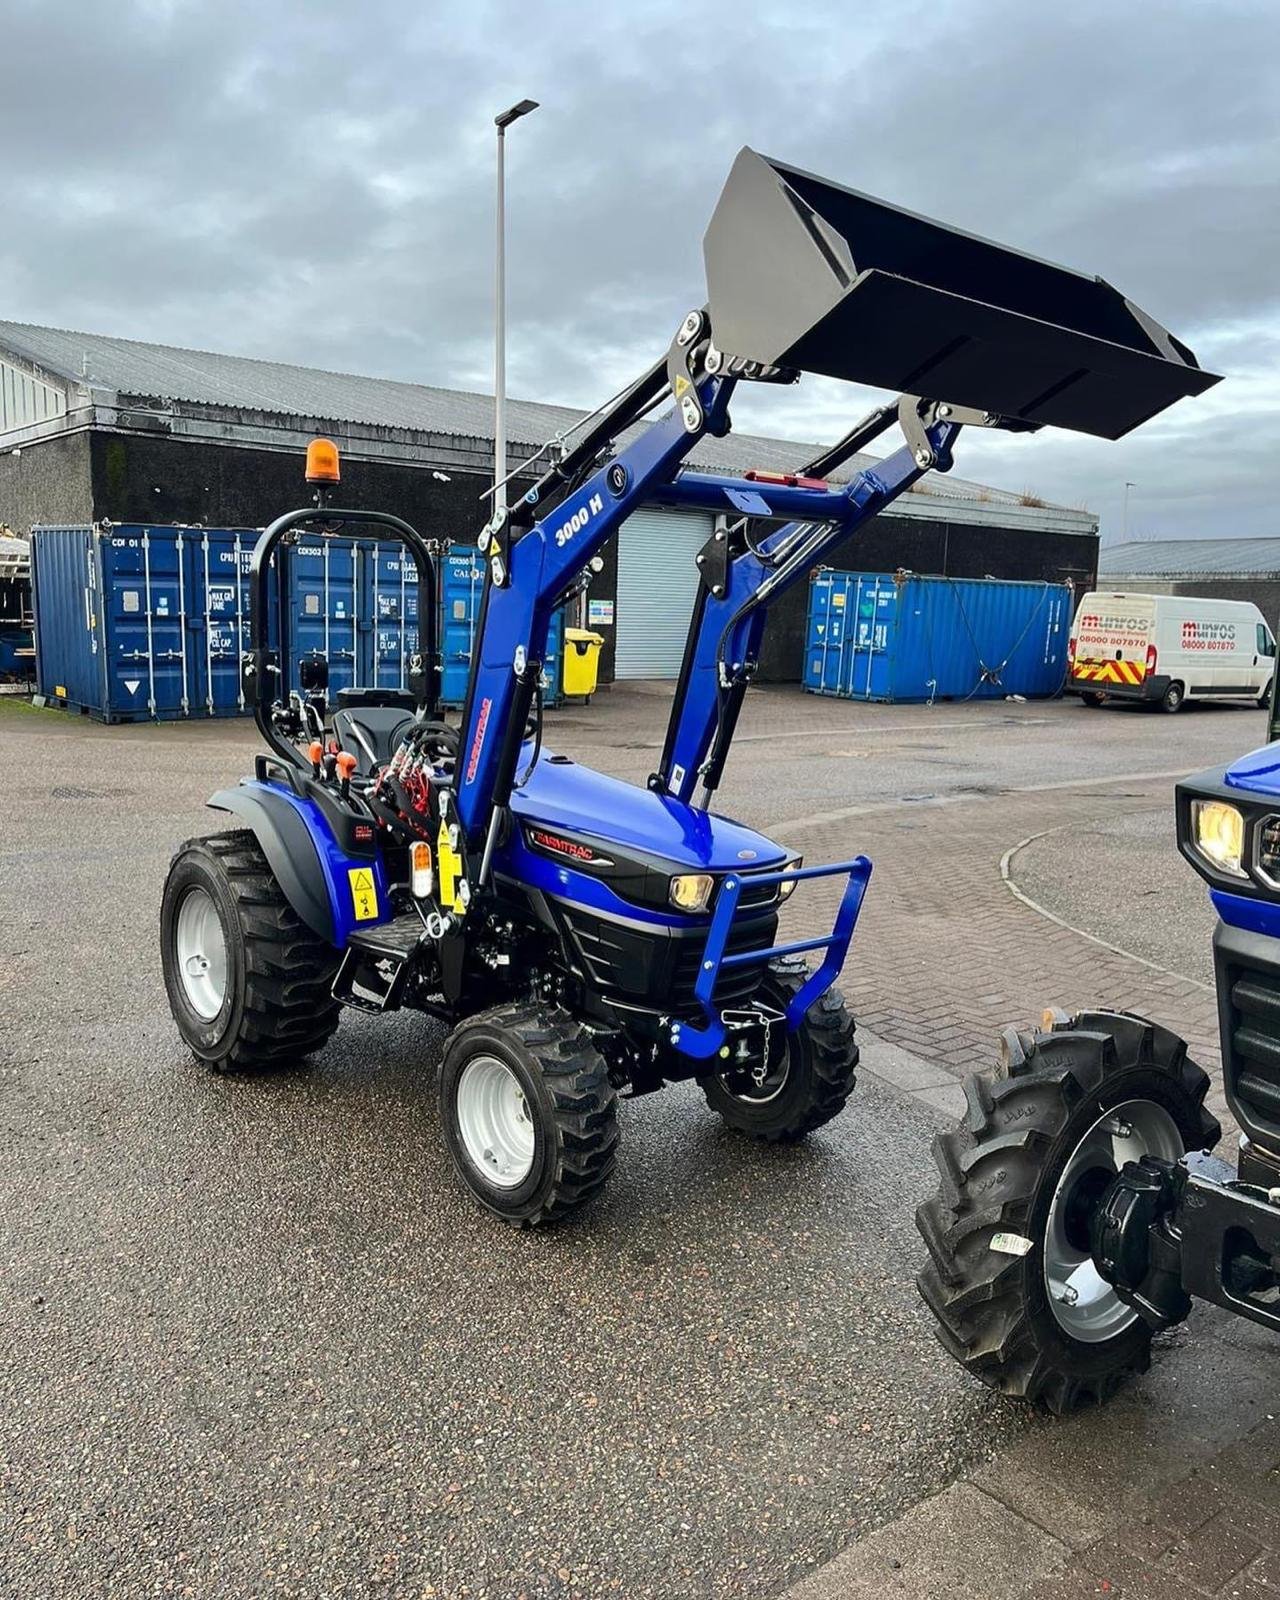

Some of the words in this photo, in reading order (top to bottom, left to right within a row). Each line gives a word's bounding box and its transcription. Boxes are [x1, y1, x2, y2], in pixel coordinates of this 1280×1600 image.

[555, 506, 589, 547] 3000
[589, 493, 604, 516] H
[1082, 615, 1149, 631] munros
[1182, 622, 1236, 639] munros
[534, 832, 593, 860] FARMTRAC
